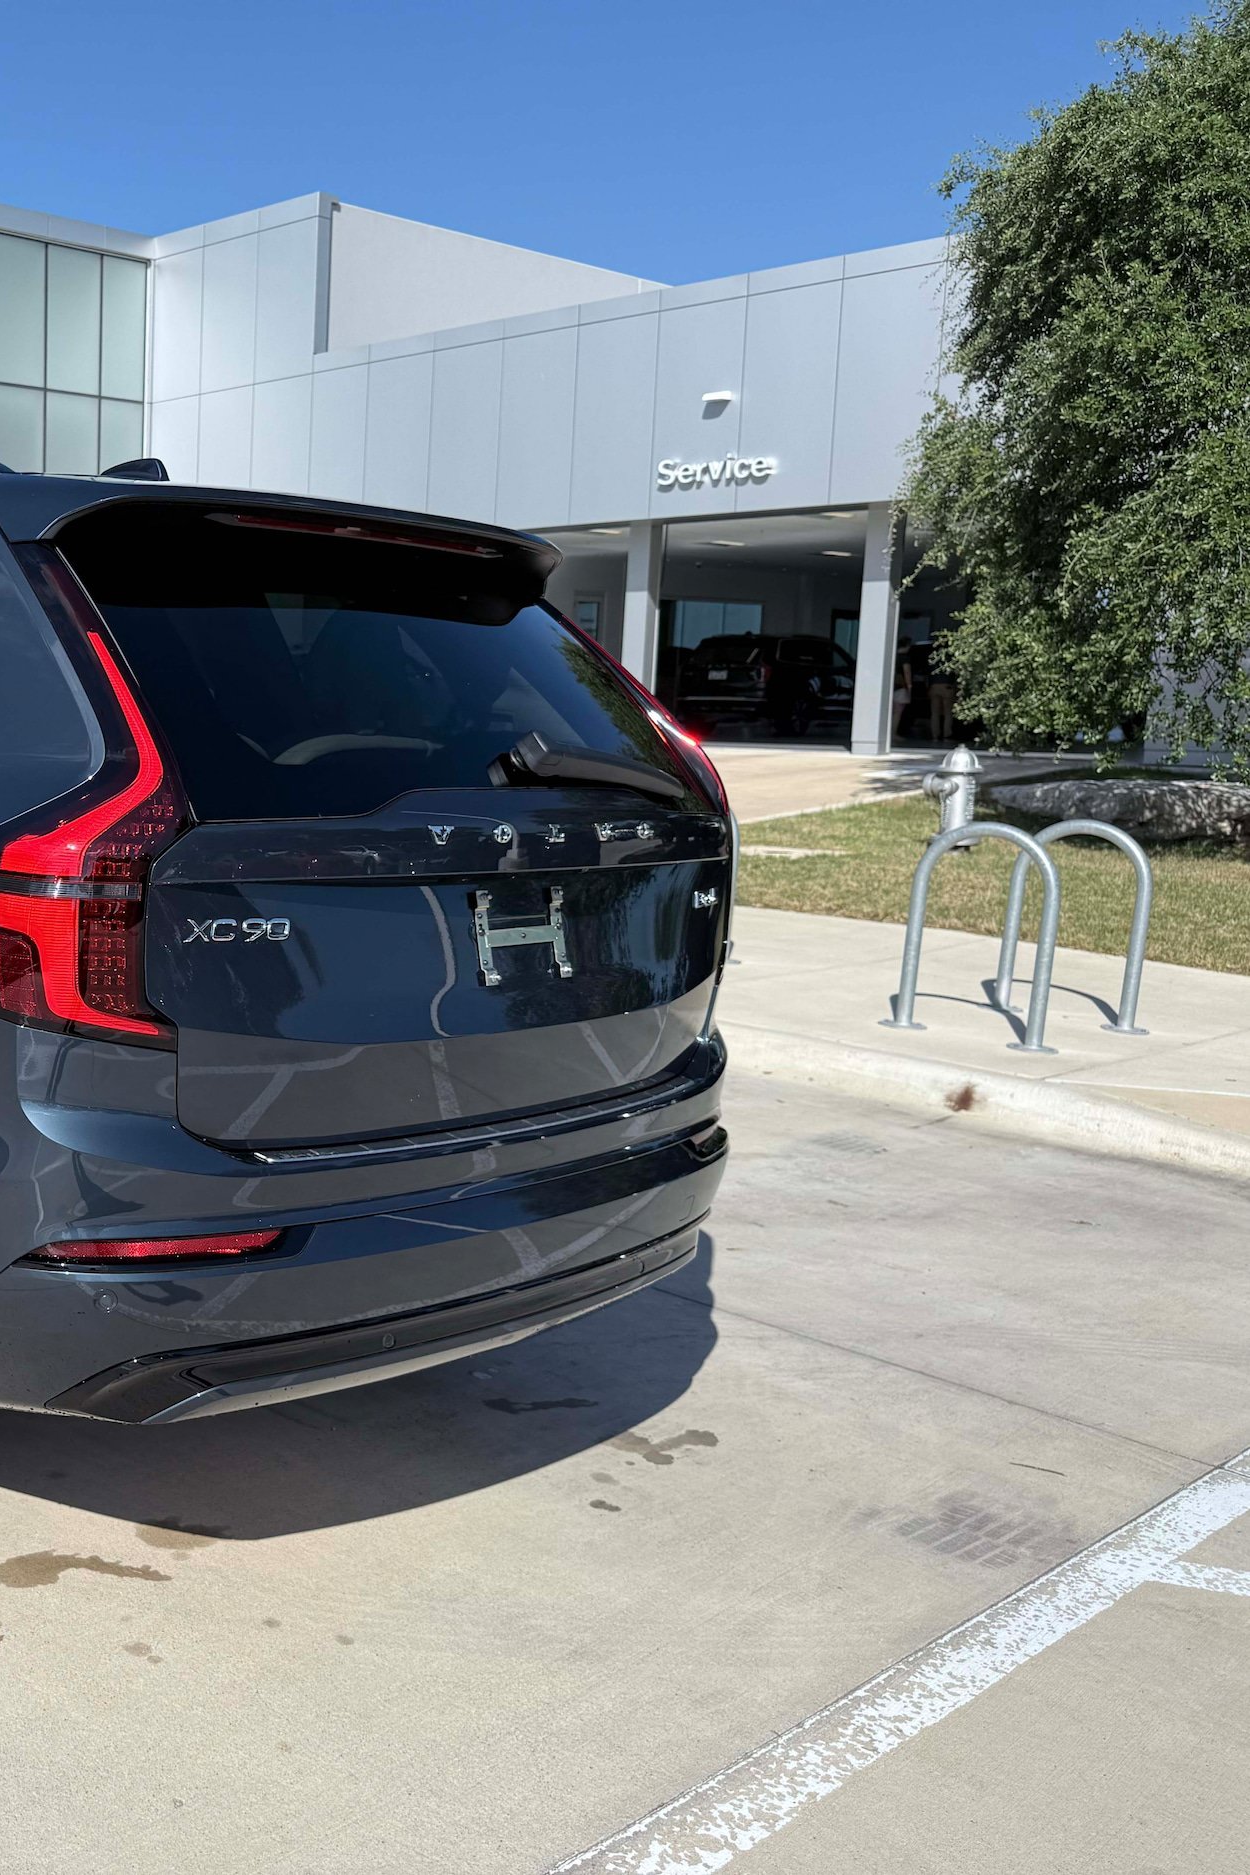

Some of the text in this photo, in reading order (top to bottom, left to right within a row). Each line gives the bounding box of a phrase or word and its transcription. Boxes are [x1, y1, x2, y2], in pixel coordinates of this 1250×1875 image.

[656, 452, 779, 486] Service
[427, 822, 655, 846] VOLVO
[182, 917, 291, 943] XC90
